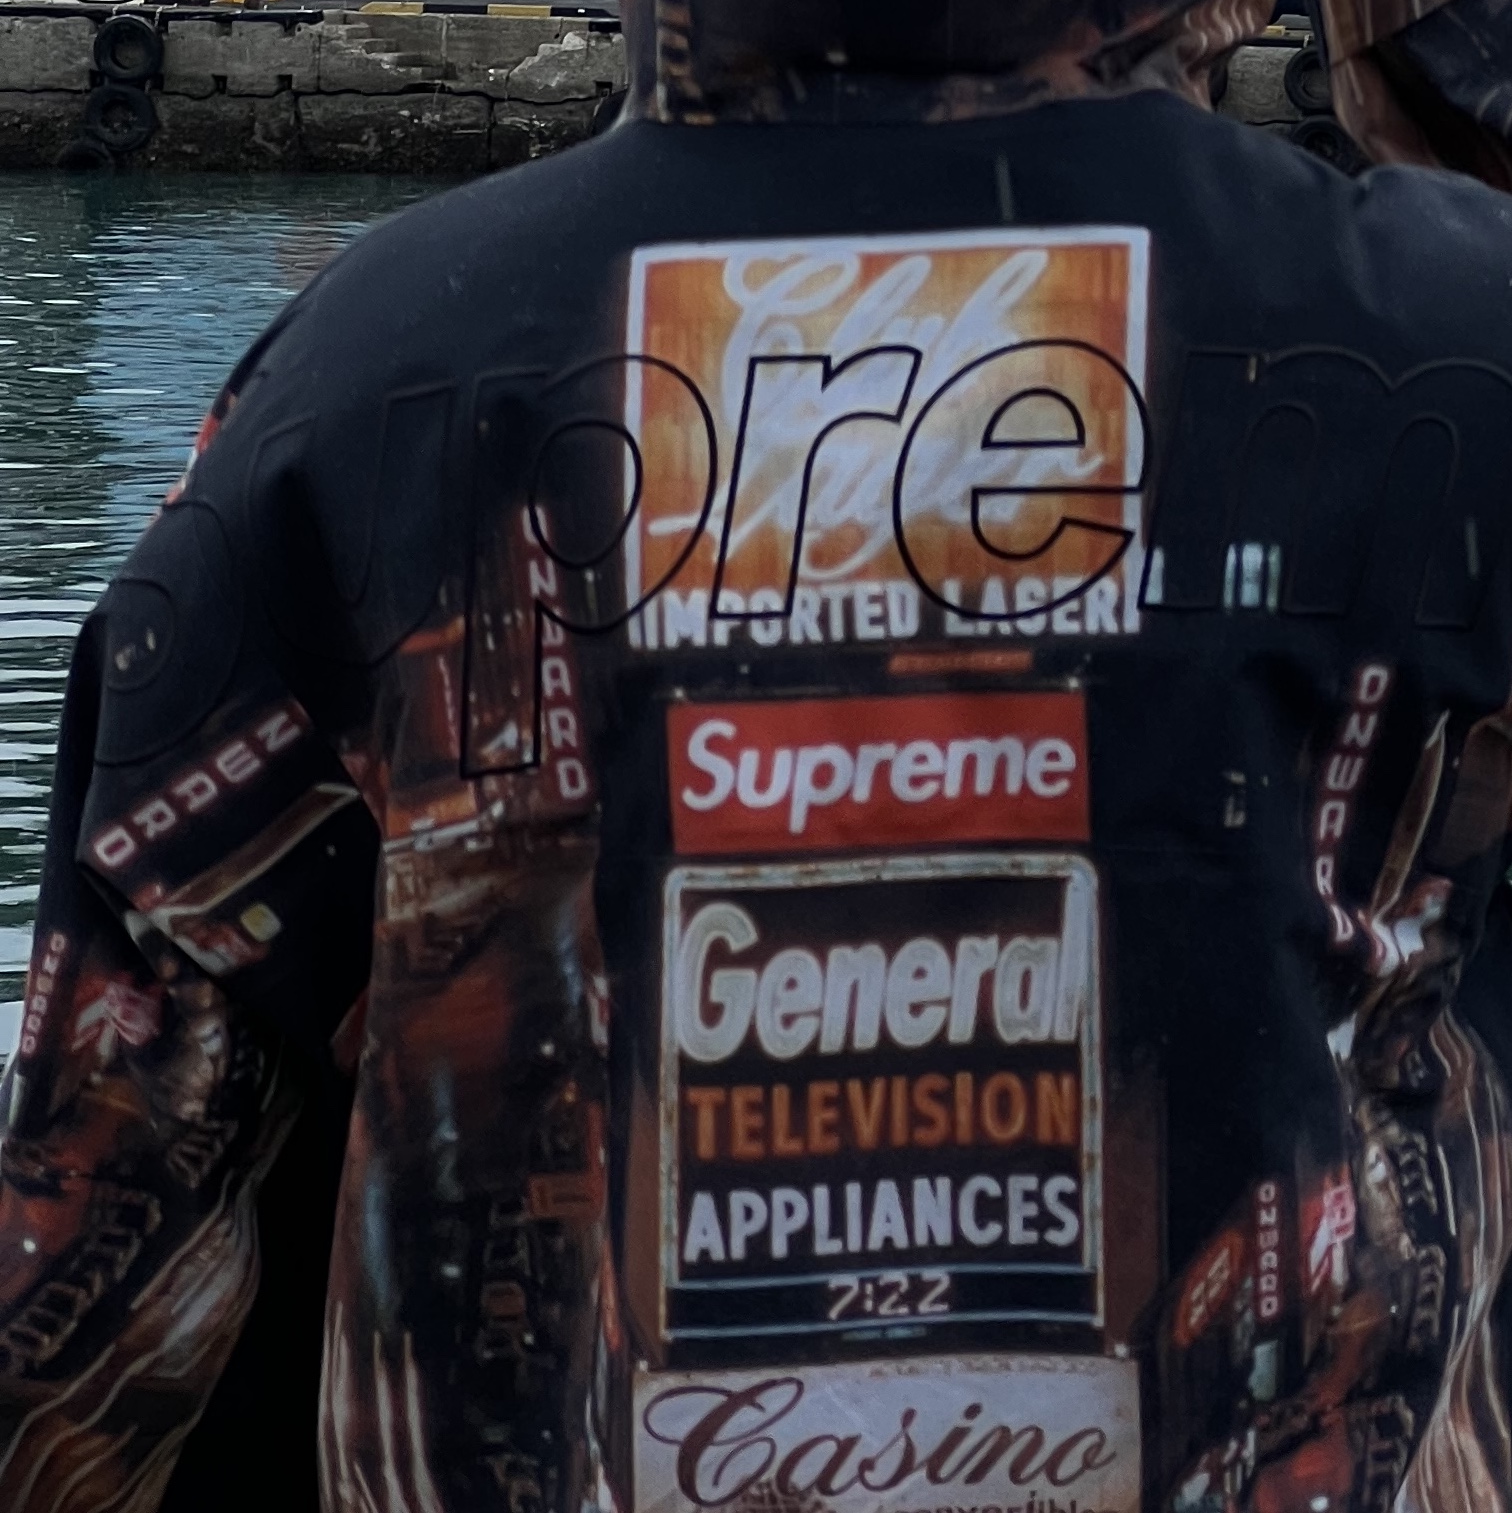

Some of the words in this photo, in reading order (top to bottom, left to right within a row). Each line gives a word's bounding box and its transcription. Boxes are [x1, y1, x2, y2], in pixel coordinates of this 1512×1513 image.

[644, 580, 920, 650] IMPORTED
[94, 713, 302, 868] NWARD
[682, 718, 1077, 834] Supreme
[1314, 664, 1389, 943] ONWARD
[679, 873, 1091, 1063] General
[687, 1071, 1079, 1162] TELEVISION
[683, 1174, 1080, 1264] APPLIANCES
[827, 1268, 952, 1320] 7:22
[643, 1376, 1117, 1507] Casino
